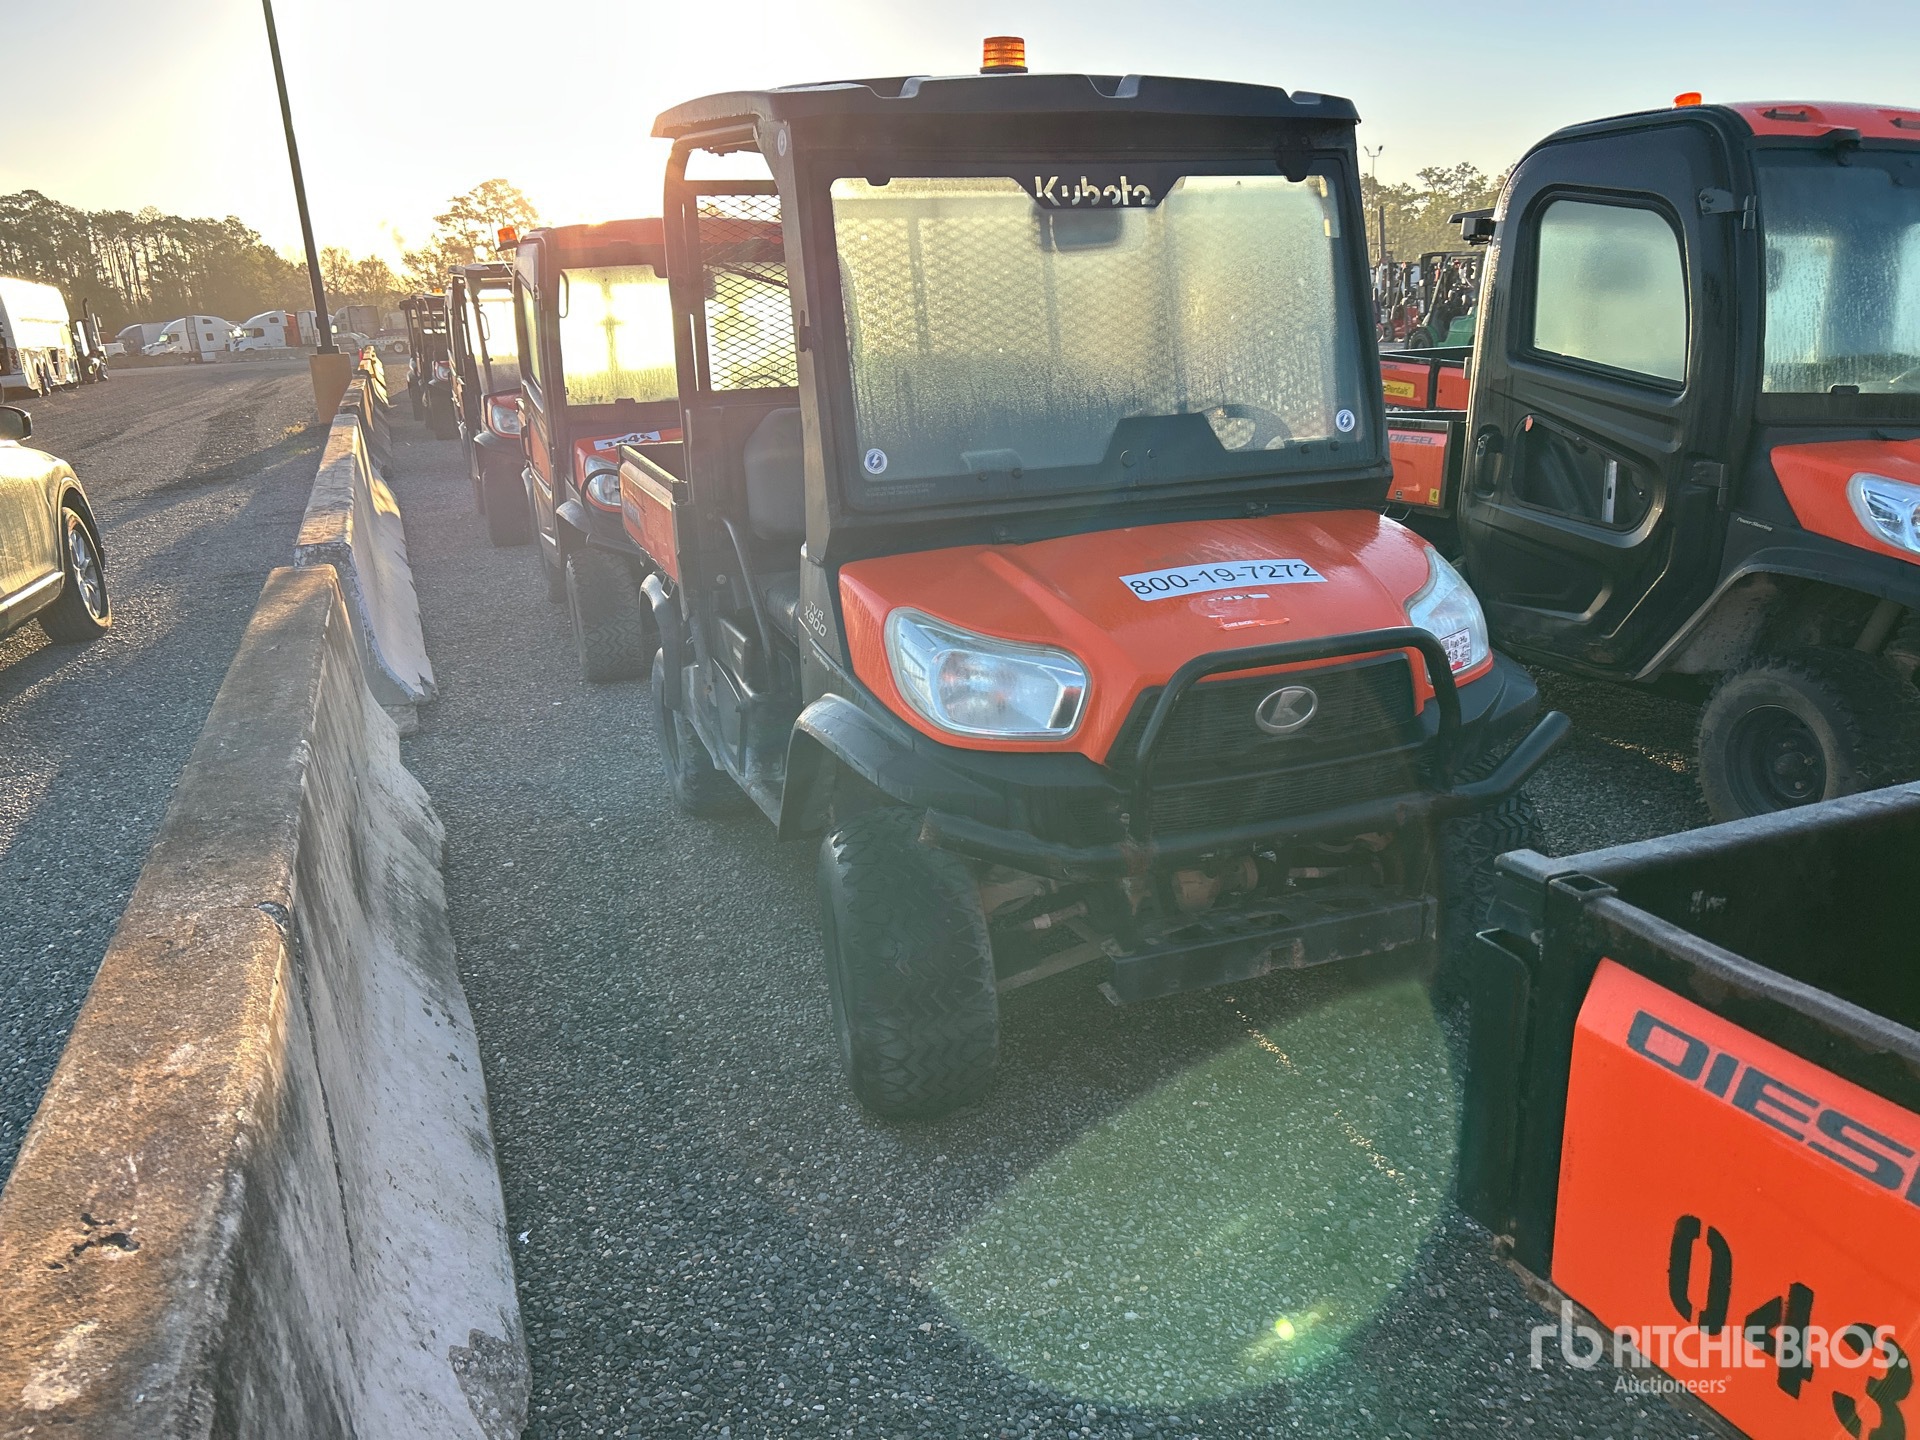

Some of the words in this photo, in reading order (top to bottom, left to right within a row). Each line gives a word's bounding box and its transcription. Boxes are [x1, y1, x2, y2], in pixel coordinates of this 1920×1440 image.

[1034, 175, 1156, 206] Kubota
[1389, 433, 1437, 446] DIESEL
[1129, 564, 1319, 595] 800-19-7272
[804, 605, 827, 637] X900
[1625, 1009, 1920, 1208] DIES
